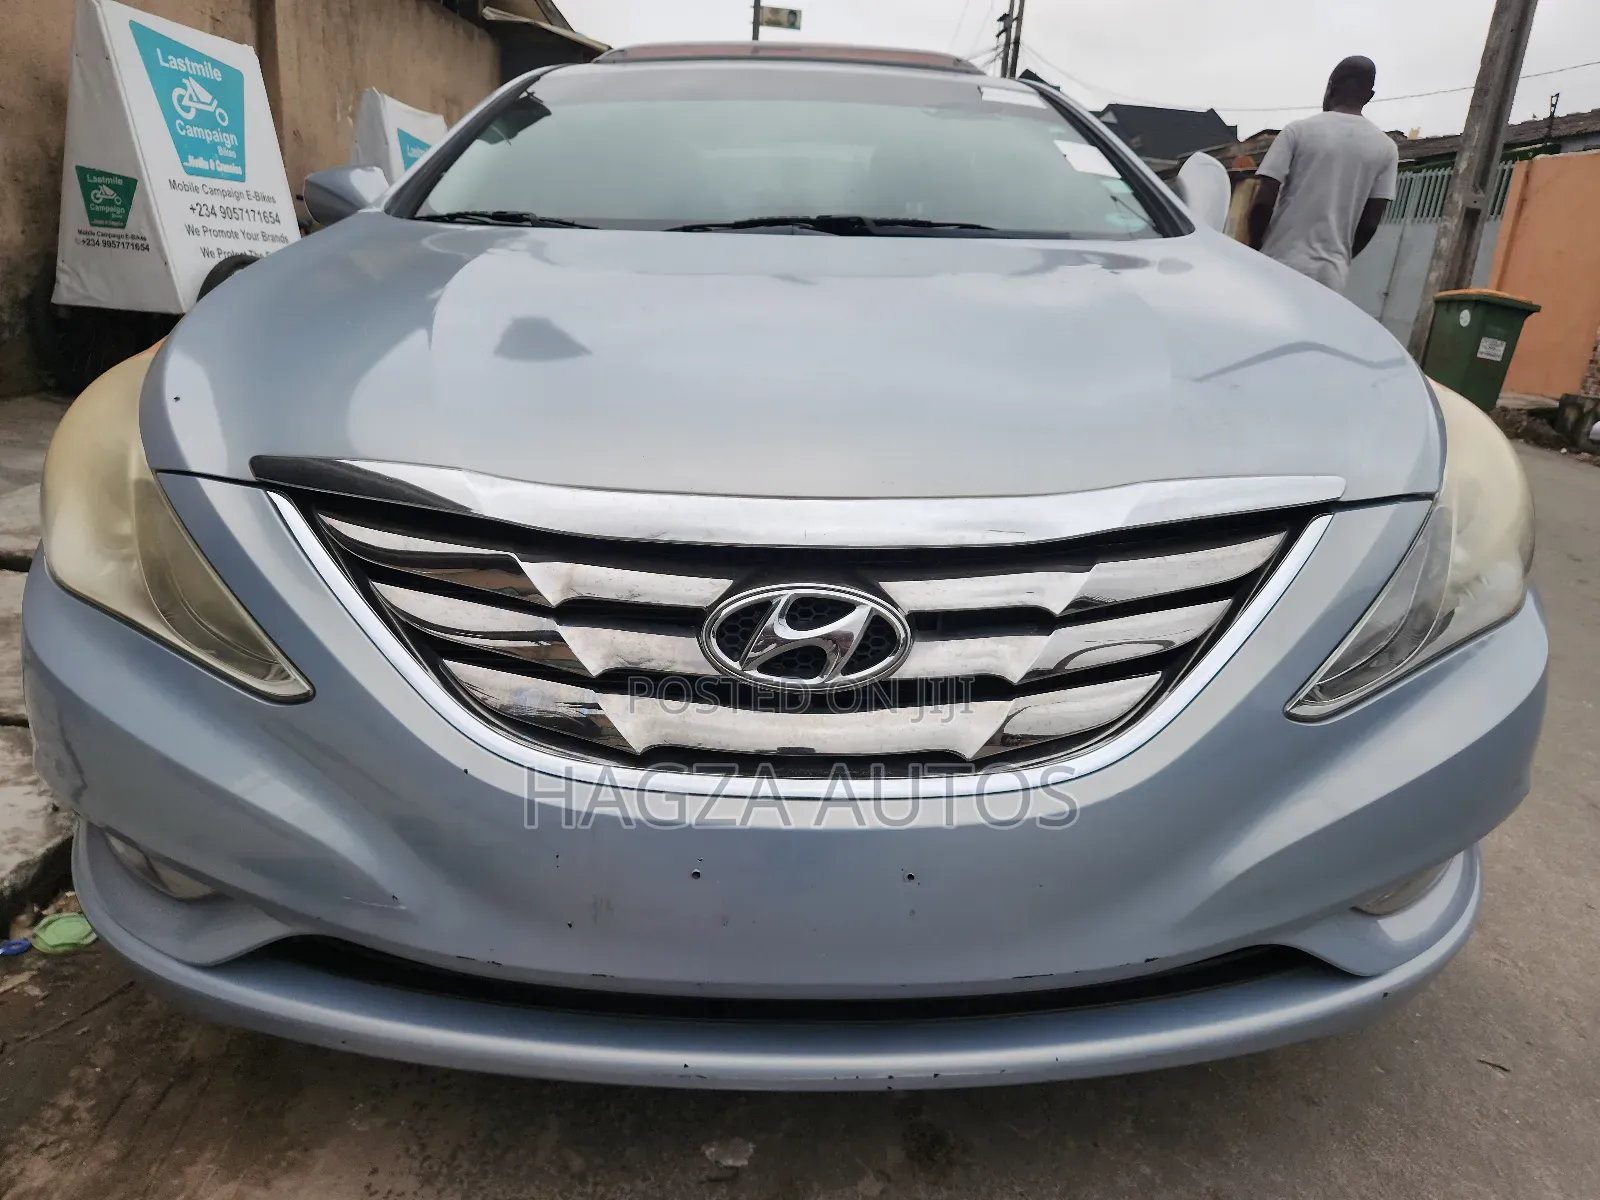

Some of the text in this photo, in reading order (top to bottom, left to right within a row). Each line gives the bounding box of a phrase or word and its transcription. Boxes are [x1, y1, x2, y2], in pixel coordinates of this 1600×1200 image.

[156, 47, 223, 81] Lastmile
[175, 119, 239, 148] Campaign
[86, 173, 124, 186] Lastmile
[168, 178, 277, 204] Mobile Campaign E-Bikes
[89, 203, 126, 214] Campaign
[189, 202, 281, 225] +234 9057171654
[96, 230, 125, 240] Campaign
[184, 223, 290, 244] We Promote Your Brands
[82, 238, 150, 252] +234 9057171654
[199, 245, 216, 259] We
